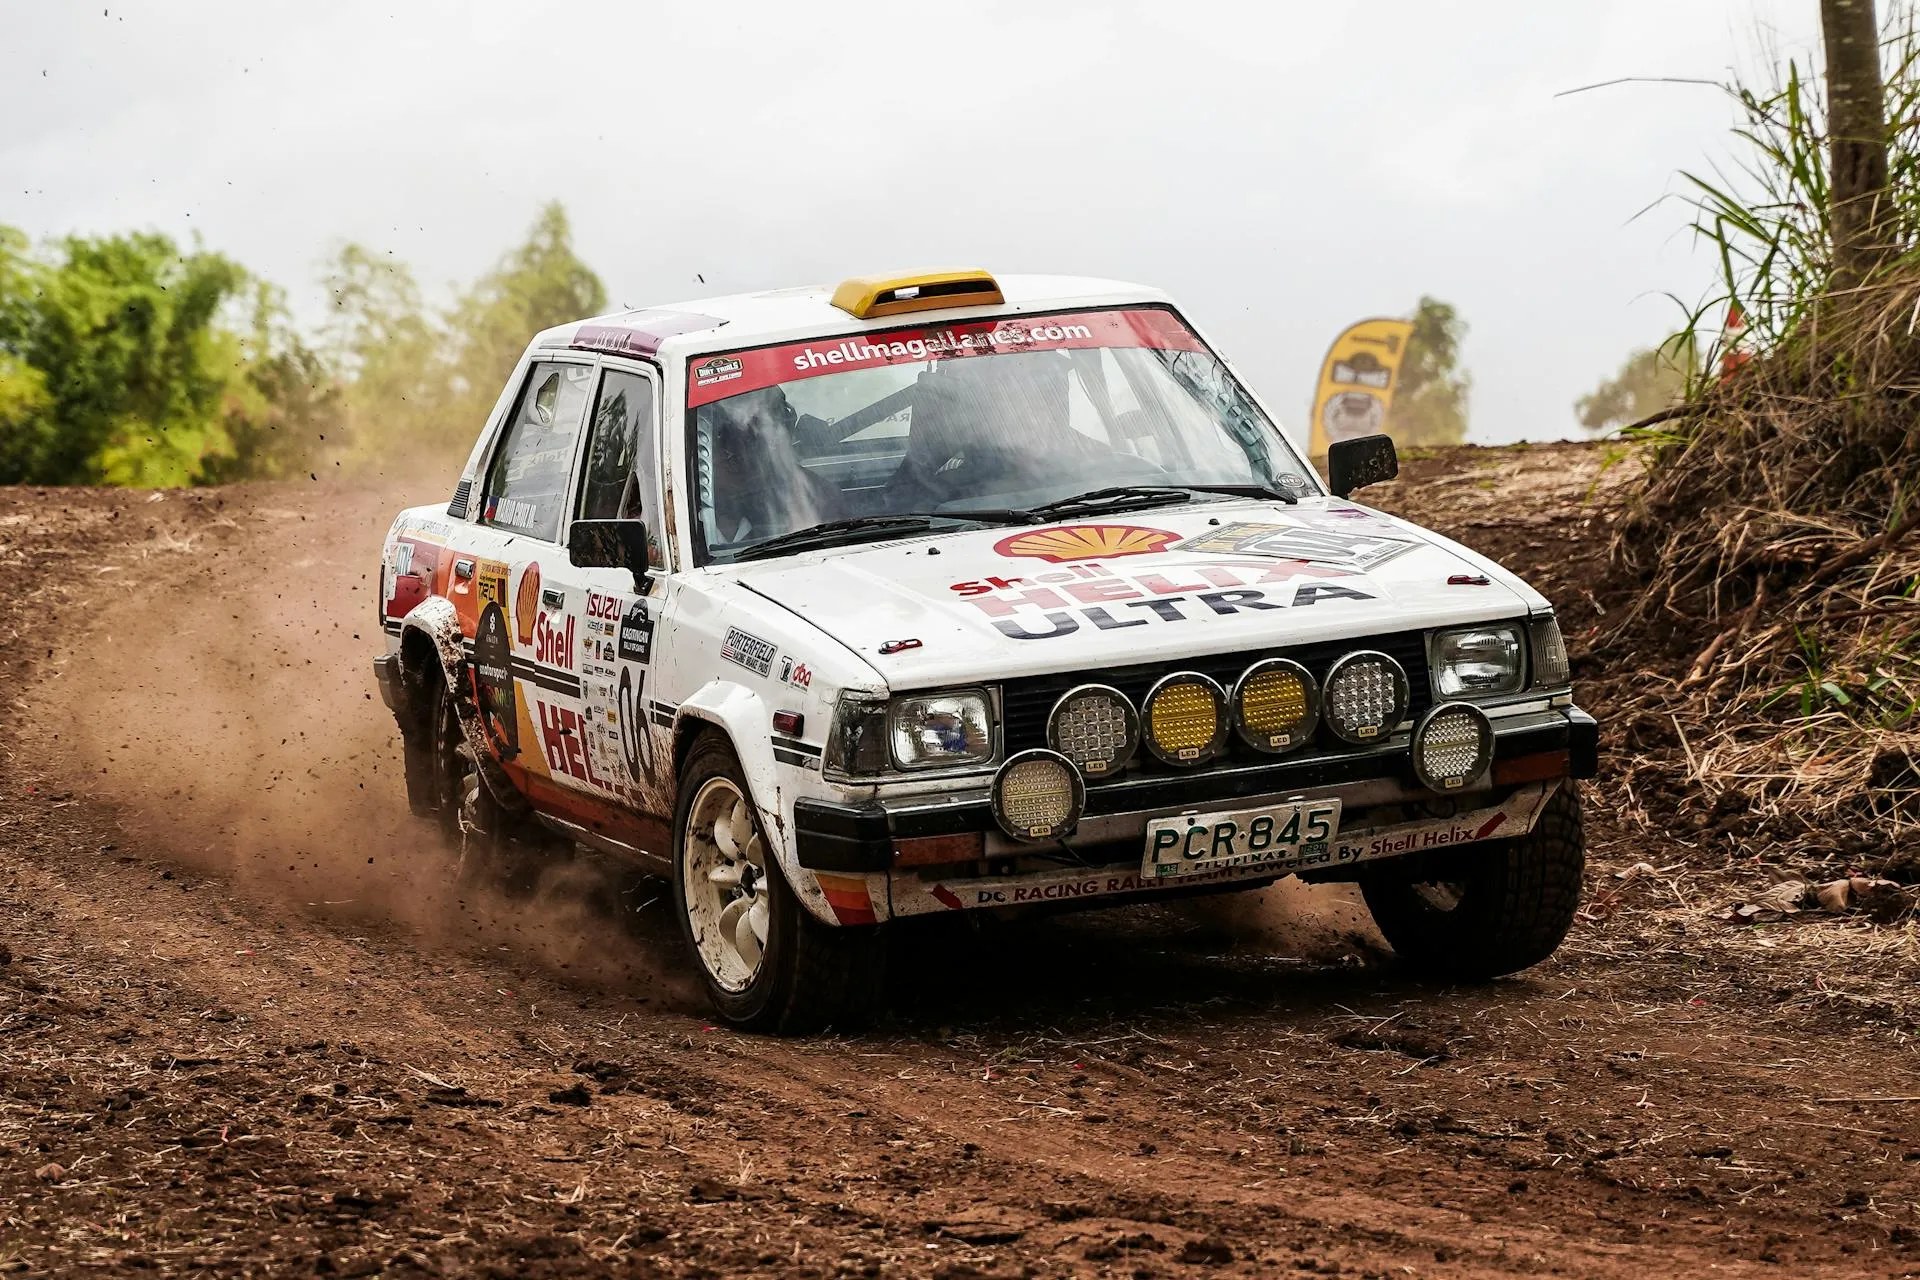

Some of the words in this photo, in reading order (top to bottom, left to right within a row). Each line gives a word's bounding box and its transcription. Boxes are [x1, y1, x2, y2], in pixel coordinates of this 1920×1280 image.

[793, 323, 1092, 370] shellmagallanes.com
[949, 564, 1114, 597] Shell
[958, 560, 1354, 617] HELIX
[586, 593, 623, 621] ISUZU
[991, 582, 1377, 640] ULTRA
[535, 610, 576, 670] Shell
[725, 630, 775, 663] PORTERFIELD
[618, 665, 655, 788] 06
[1272, 736, 1290, 745] LED
[1358, 727, 1376, 736] LED
[1088, 761, 1105, 771] LED
[1181, 749, 1199, 758] LED
[1032, 826, 1050, 836] LED
[978, 890, 1006, 903] DC
[1014, 880, 1099, 901] RACING
[1338, 845, 1364, 863] By
[1370, 834, 1416, 856] Shell
[1423, 827, 1475, 846] Helix
[1195, 849, 1288, 871] PILIPINAS
